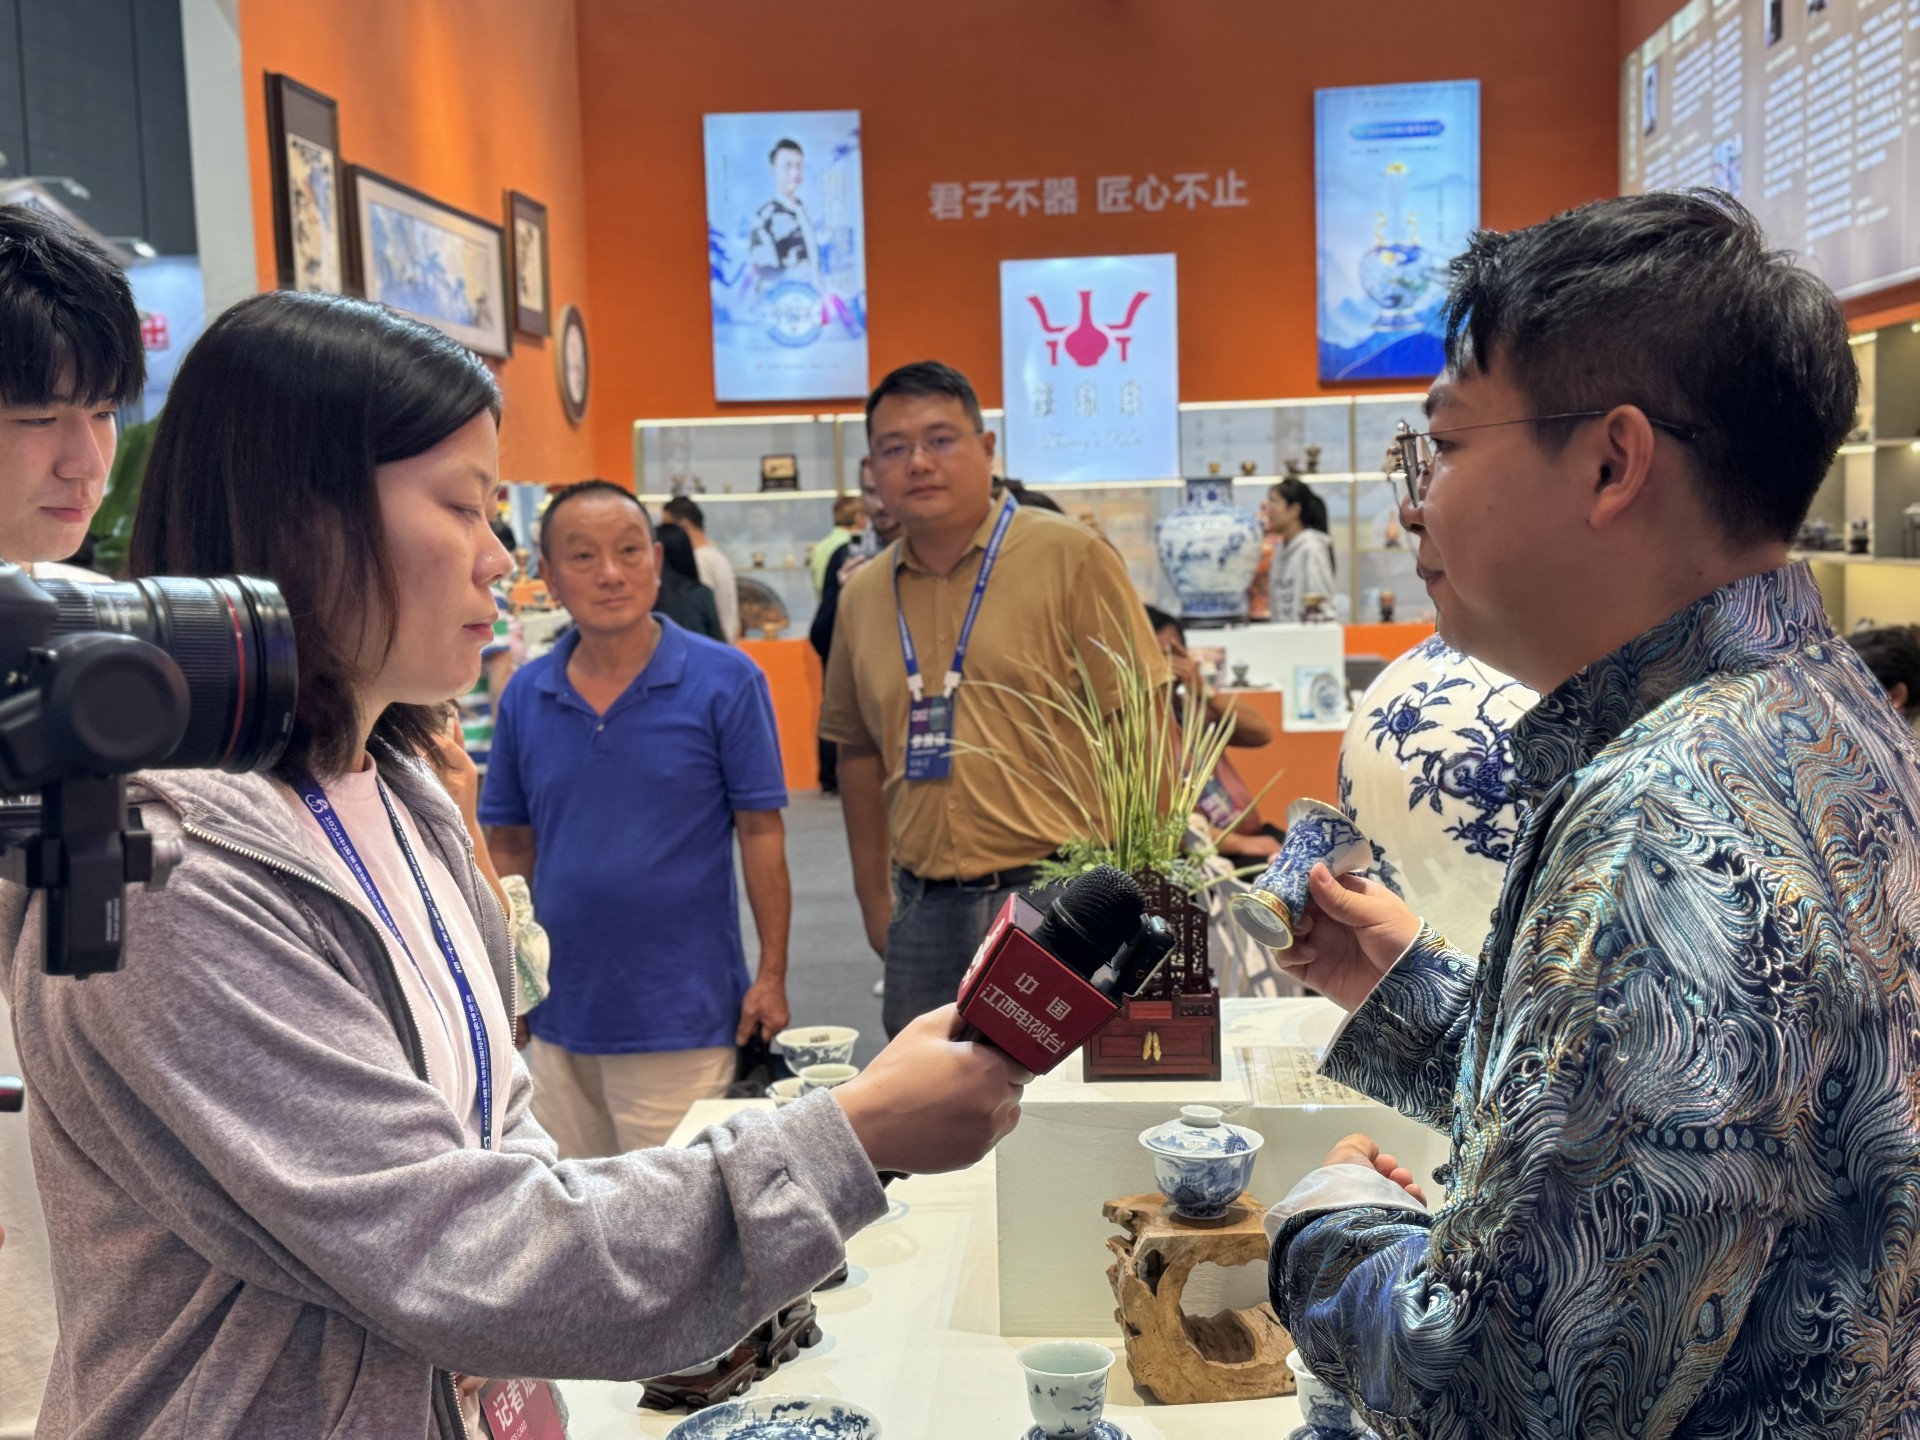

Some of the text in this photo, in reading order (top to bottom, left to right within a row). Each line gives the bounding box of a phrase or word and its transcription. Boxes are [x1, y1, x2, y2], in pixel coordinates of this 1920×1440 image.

[929, 170, 1249, 219] 君子不器 匠心不止
[979, 983, 1066, 1055] 江西电视台
[1014, 972, 1072, 1022] 中国
